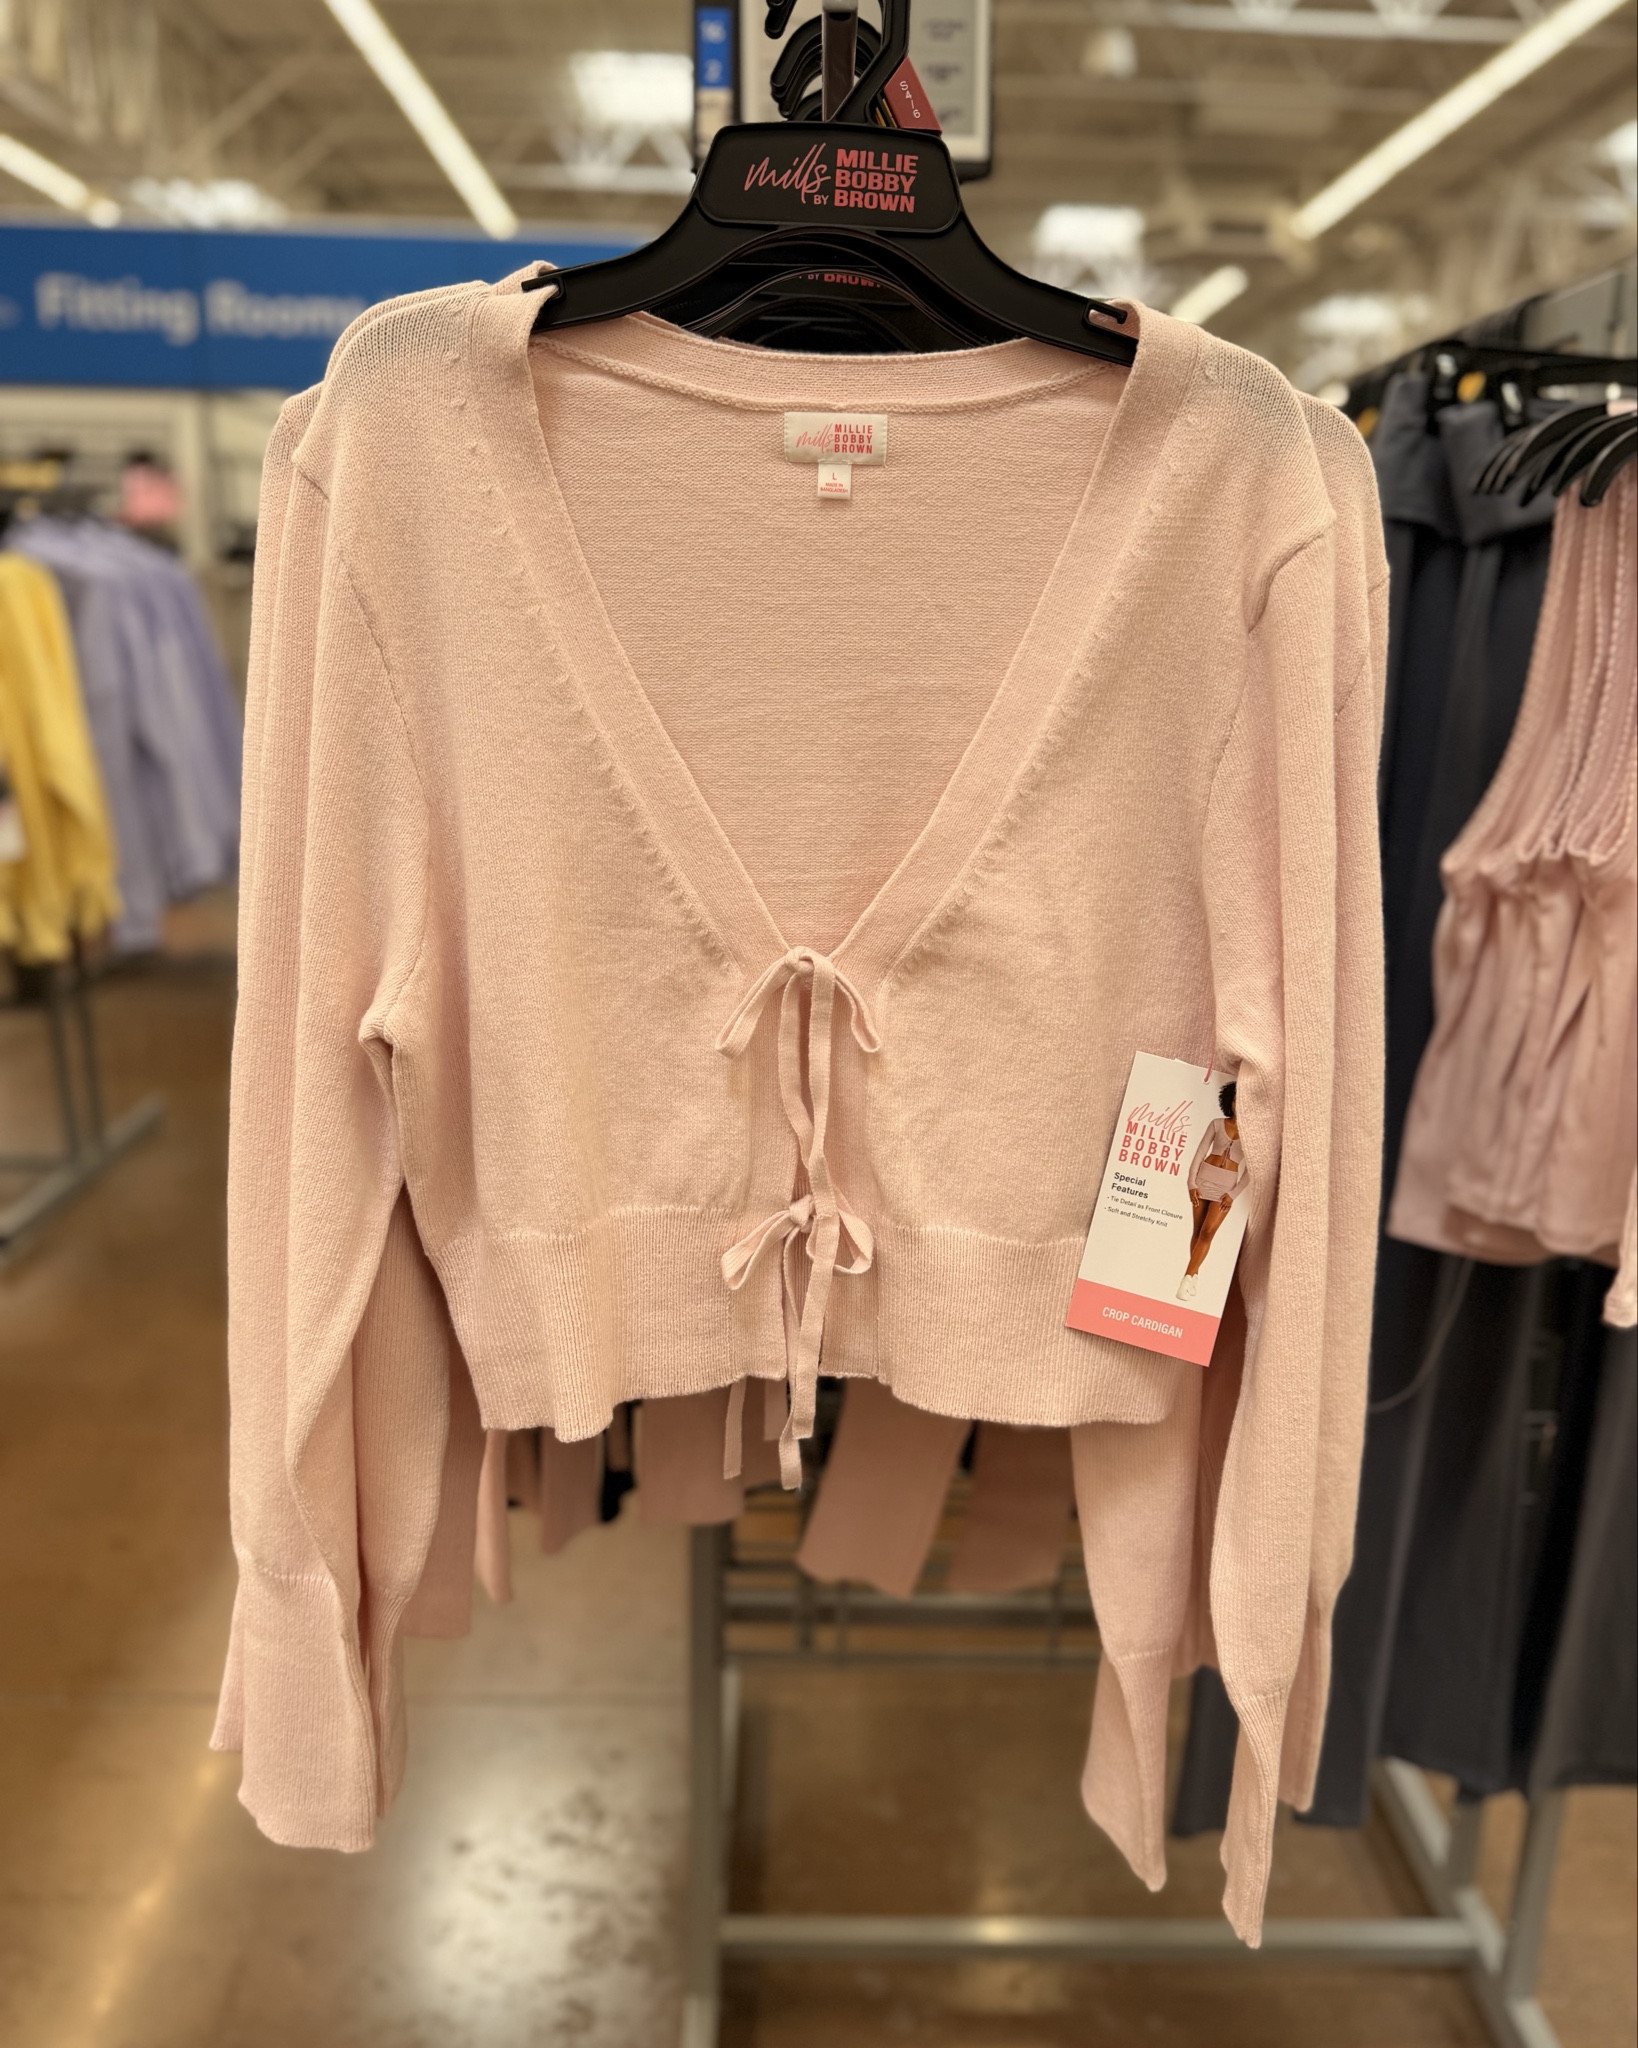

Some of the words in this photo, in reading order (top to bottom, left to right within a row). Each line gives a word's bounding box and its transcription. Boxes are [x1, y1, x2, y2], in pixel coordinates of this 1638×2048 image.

[744, 142, 832, 204] mills
[813, 195, 829, 205] BY
[836, 148, 919, 174] MILLIE
[835, 169, 916, 194] BOBBY
[834, 189, 916, 213] BROWN
[37, 273, 198, 345] Fitting
[834, 424, 873, 434] MILLIE
[834, 434, 873, 444] BOBBY
[834, 444, 873, 454] BROWN
[832, 472, 838, 481] L
[1127, 1100, 1193, 1140] mills
[1125, 1121, 1188, 1148] MILLIE
[1122, 1135, 1184, 1161] BOBBY
[1118, 1149, 1180, 1176] BROWN
[1111, 1182, 1149, 1199] Features
[1114, 1171, 1147, 1187] Special
[1107, 1206, 1119, 1214] Soft
[1120, 1209, 1132, 1218] and
[1132, 1213, 1155, 1225] Stretchy
[1156, 1219, 1168, 1228] Knit
[1111, 1195, 1120, 1203] Tie
[1120, 1198, 1137, 1207] Detail
[1145, 1205, 1161, 1214] Front
[1161, 1209, 1184, 1220] Closure
[1102, 1306, 1130, 1322] CROP
[1131, 1315, 1184, 1339] CARDIGAN
